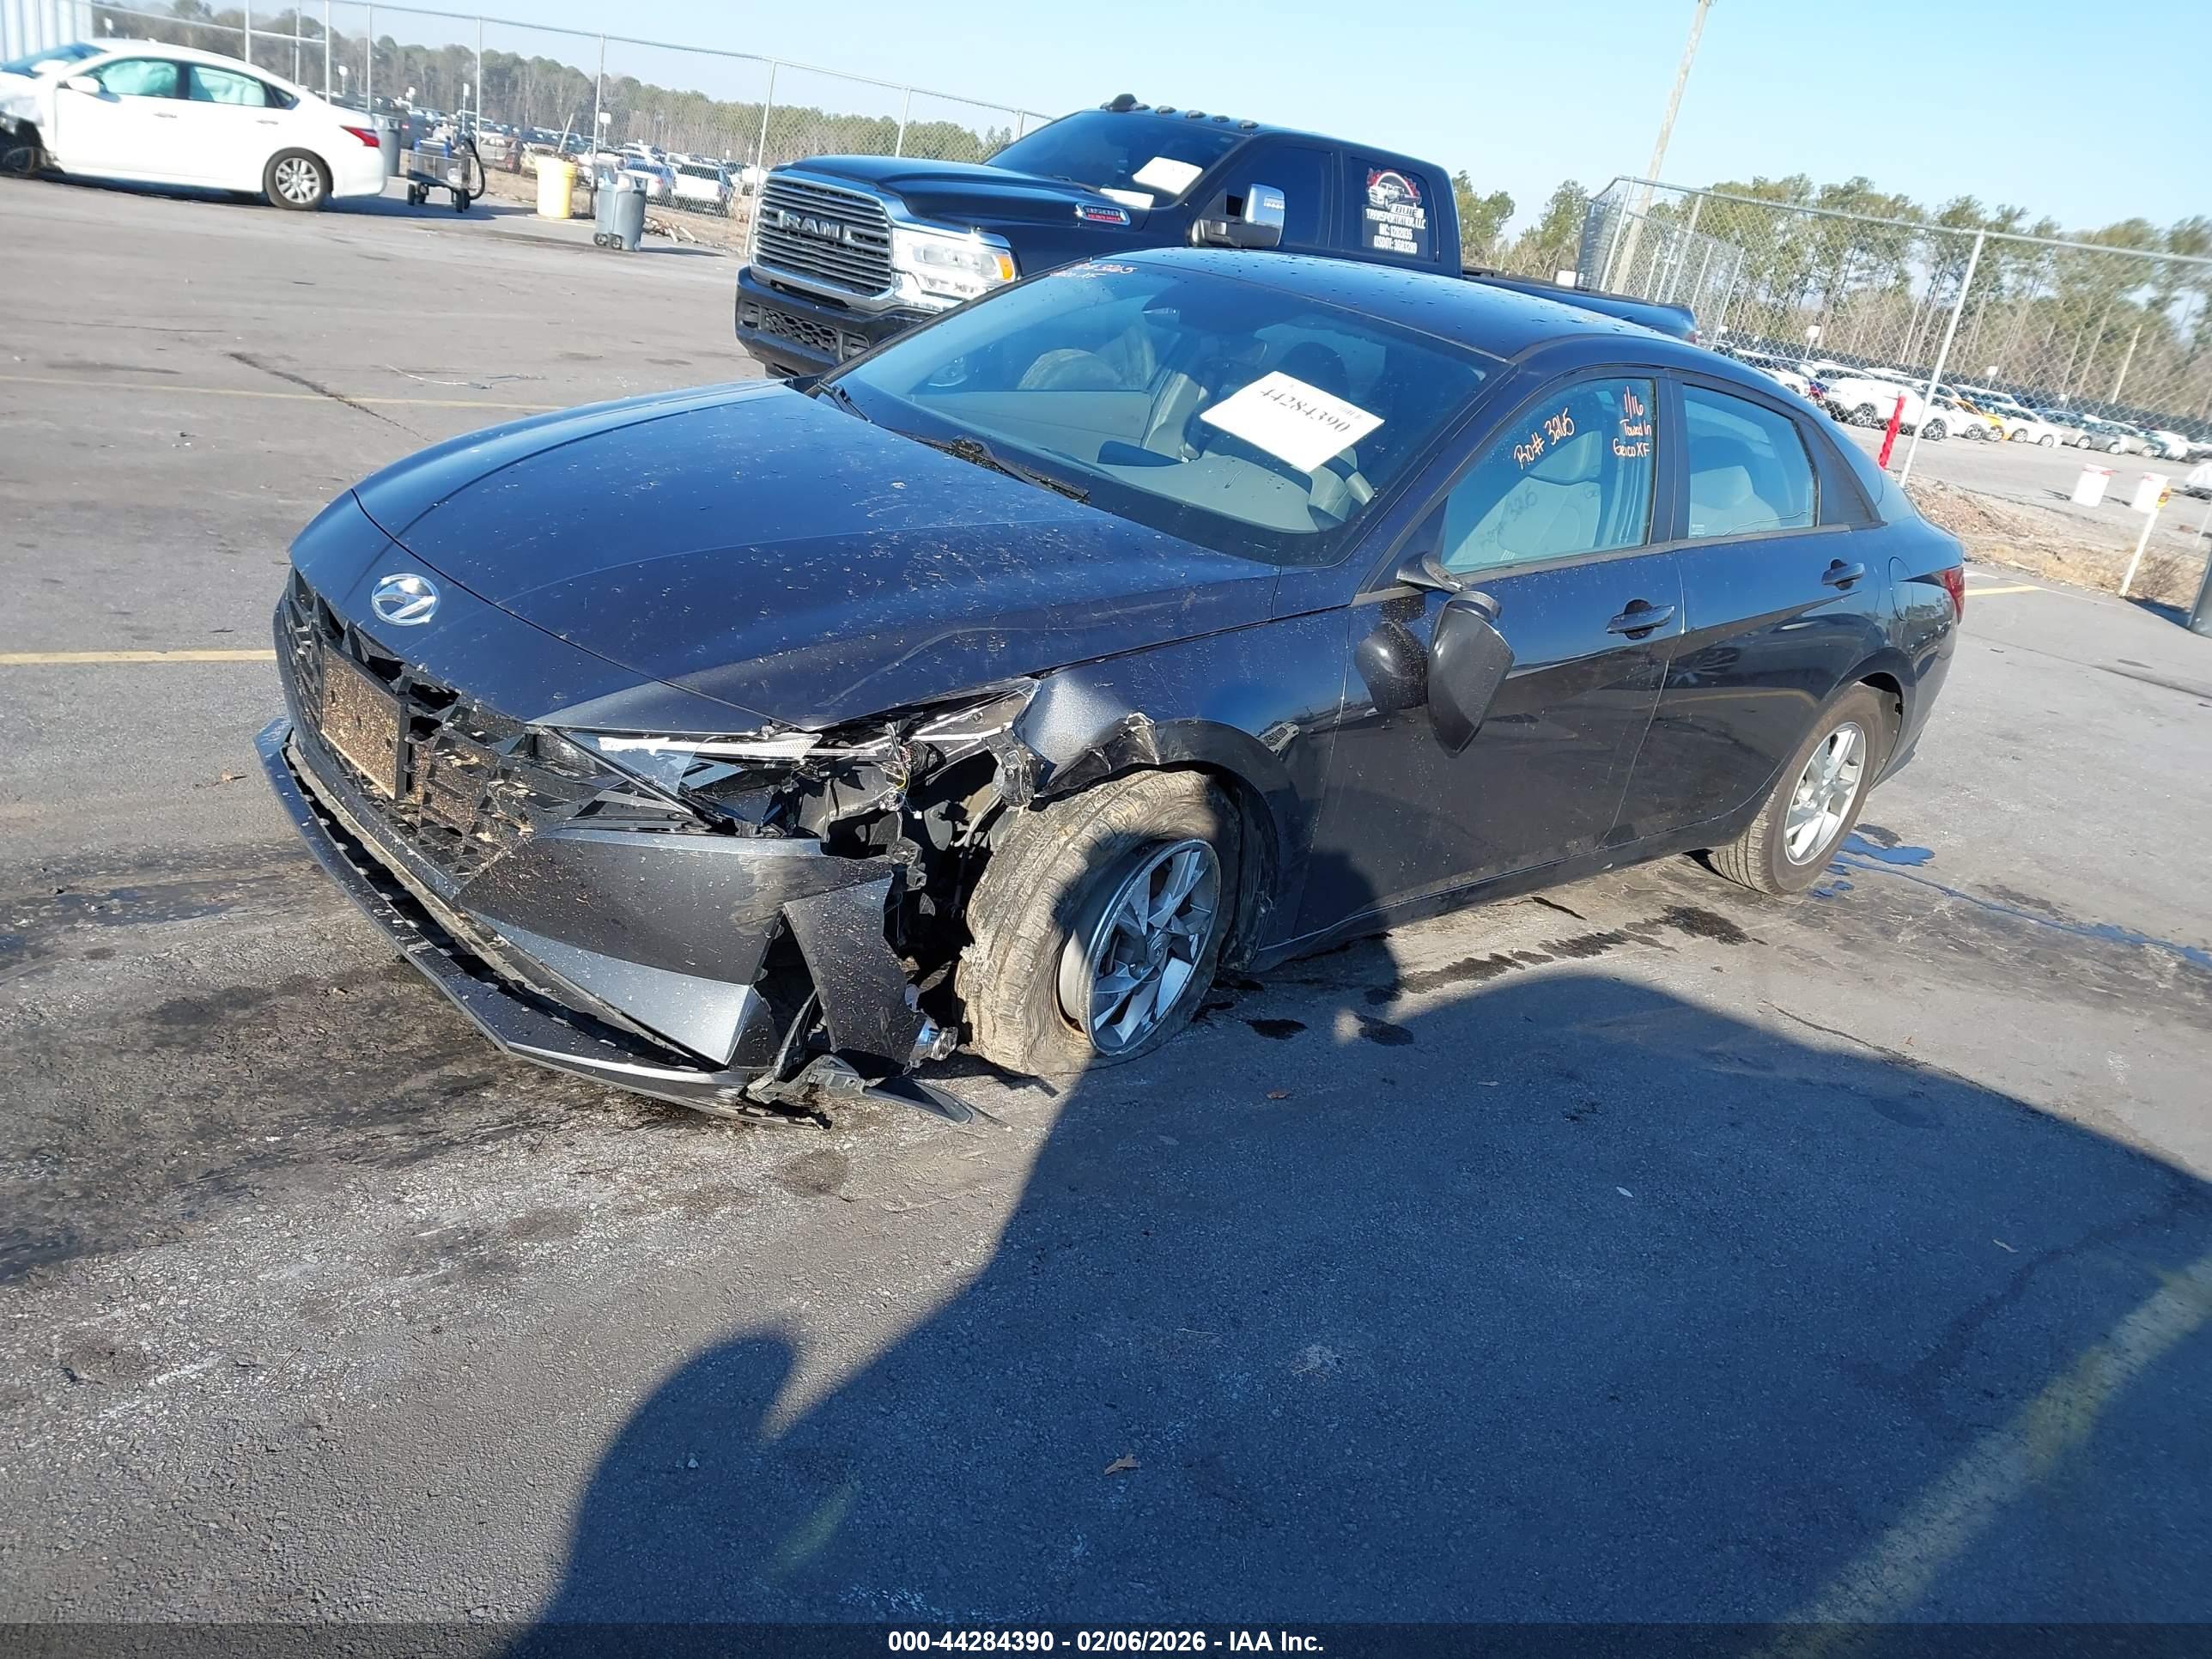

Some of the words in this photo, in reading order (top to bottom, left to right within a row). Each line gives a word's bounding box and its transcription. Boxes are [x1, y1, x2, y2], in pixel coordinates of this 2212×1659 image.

[778, 210, 840, 239] RAM
[1415, 217, 1426, 229] LLC
[1623, 386, 1644, 419] 1/16
